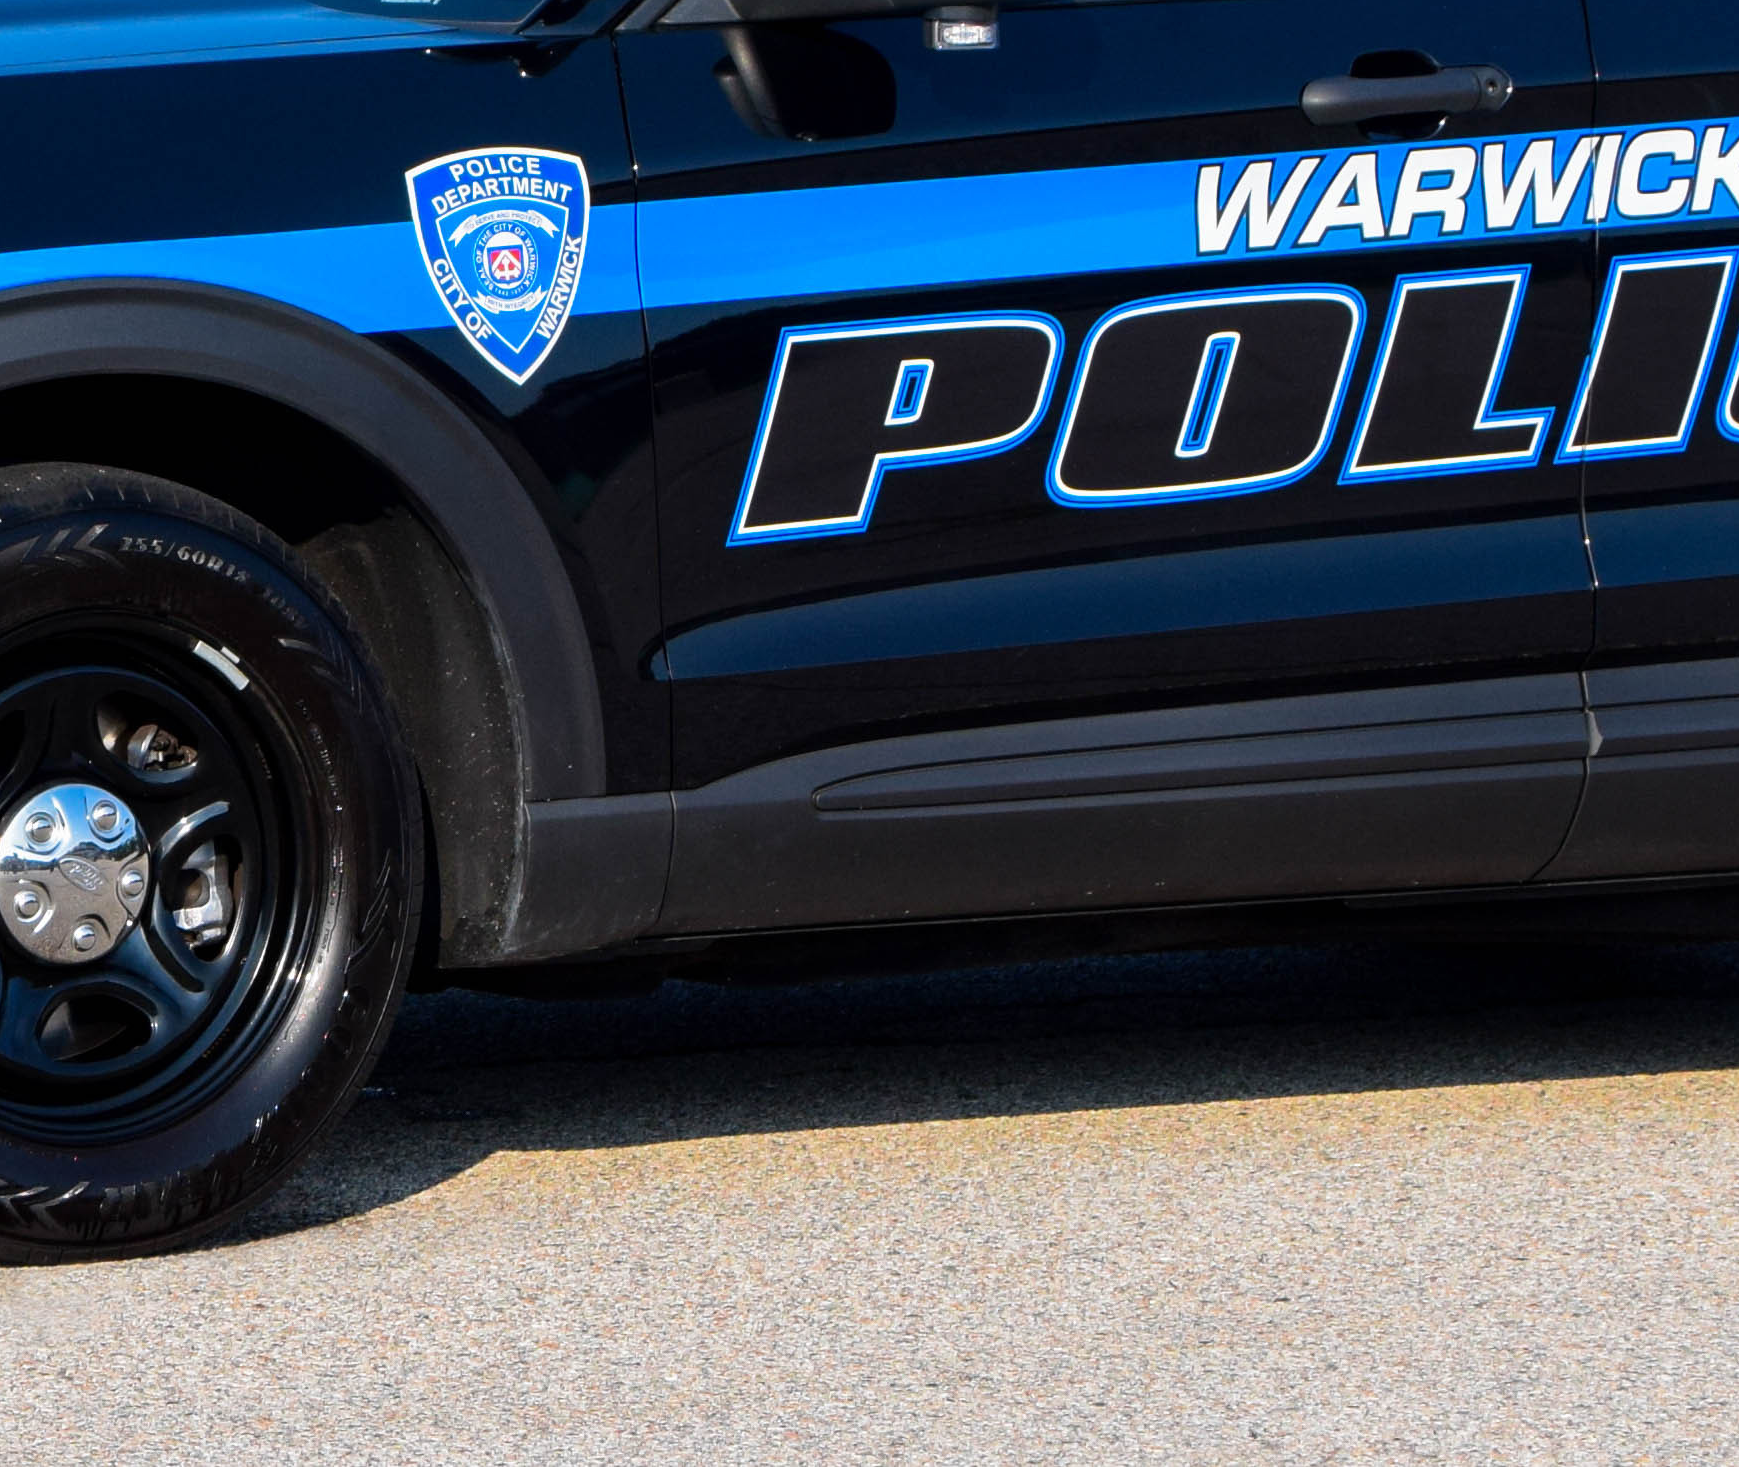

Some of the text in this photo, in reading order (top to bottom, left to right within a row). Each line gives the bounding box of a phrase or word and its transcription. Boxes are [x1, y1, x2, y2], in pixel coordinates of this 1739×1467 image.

[448, 156, 542, 182] POLICE
[431, 176, 573, 215] DEPARTMENT
[493, 222, 513, 233] CITY
[433, 258, 493, 341] CITY OF
[535, 235, 582, 339] WARWICK
